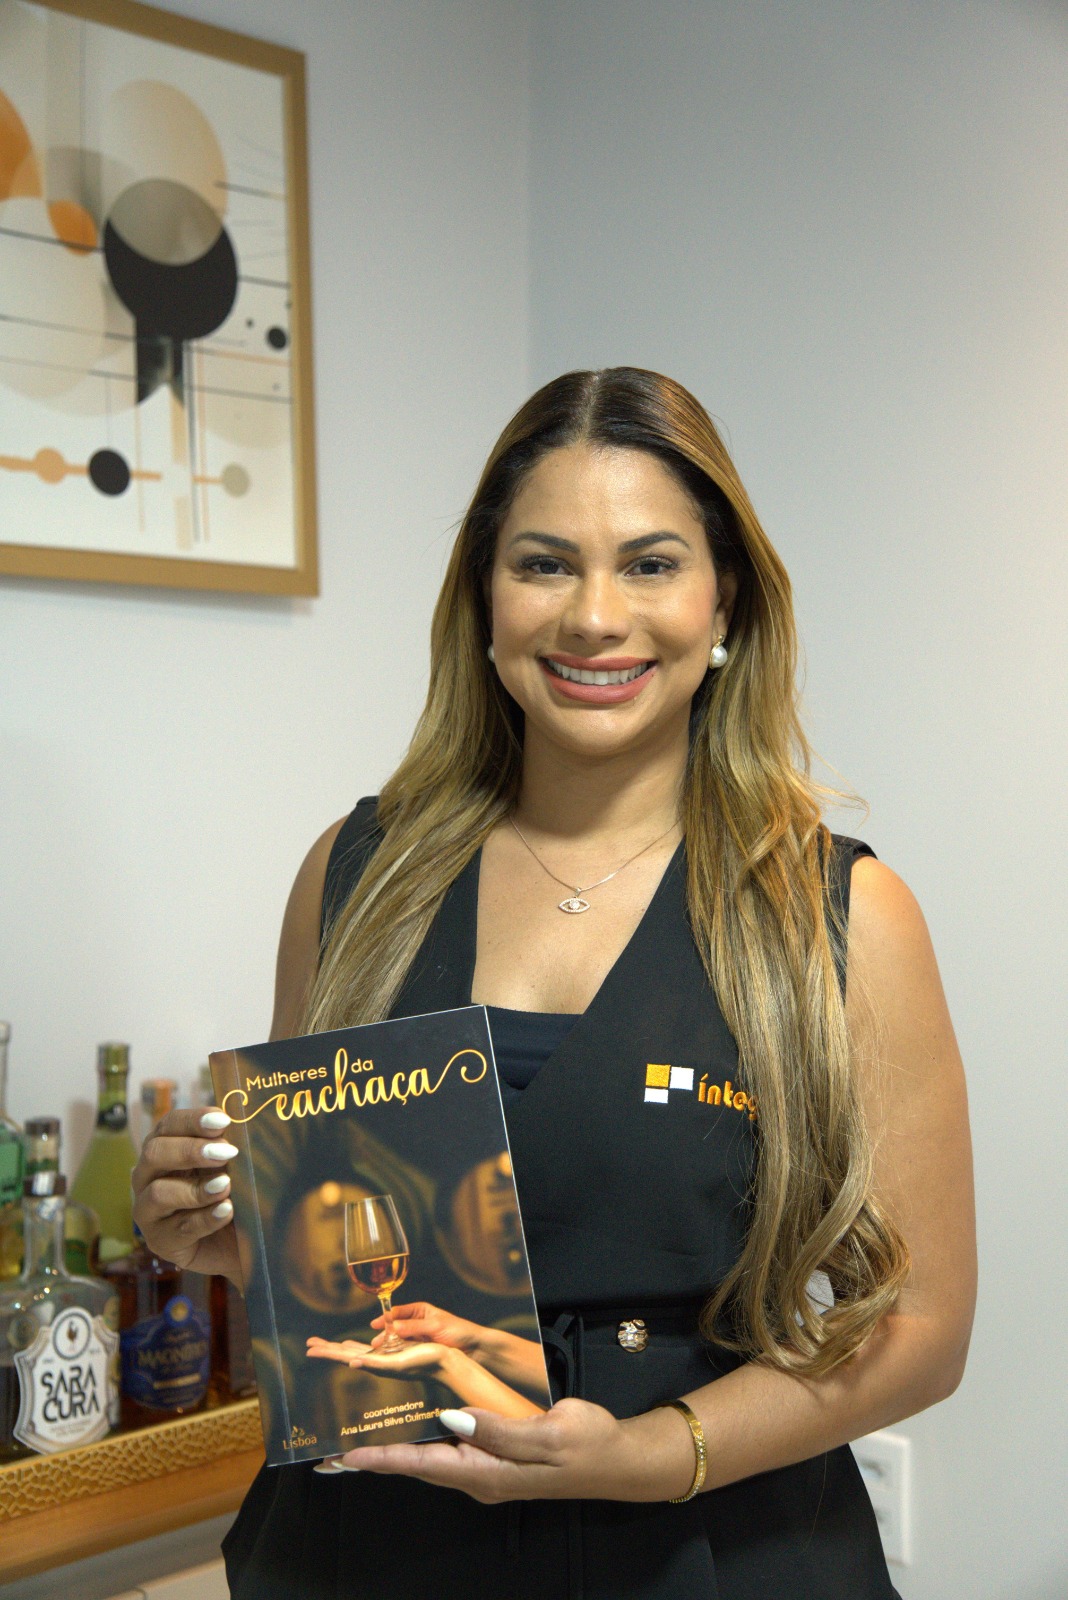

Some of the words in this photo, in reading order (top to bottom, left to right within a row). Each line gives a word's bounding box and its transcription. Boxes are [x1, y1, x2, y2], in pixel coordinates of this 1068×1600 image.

[246, 1066, 328, 1091] Mulheres
[350, 1058, 374, 1074] da
[41, 1363, 97, 1397] SARA
[43, 1389, 100, 1422] CURA
[283, 1435, 317, 1450] Lisboa
[340, 1426, 358, 1436] Ana
[358, 1419, 383, 1433] Laura
[383, 1416, 404, 1427] Silva
